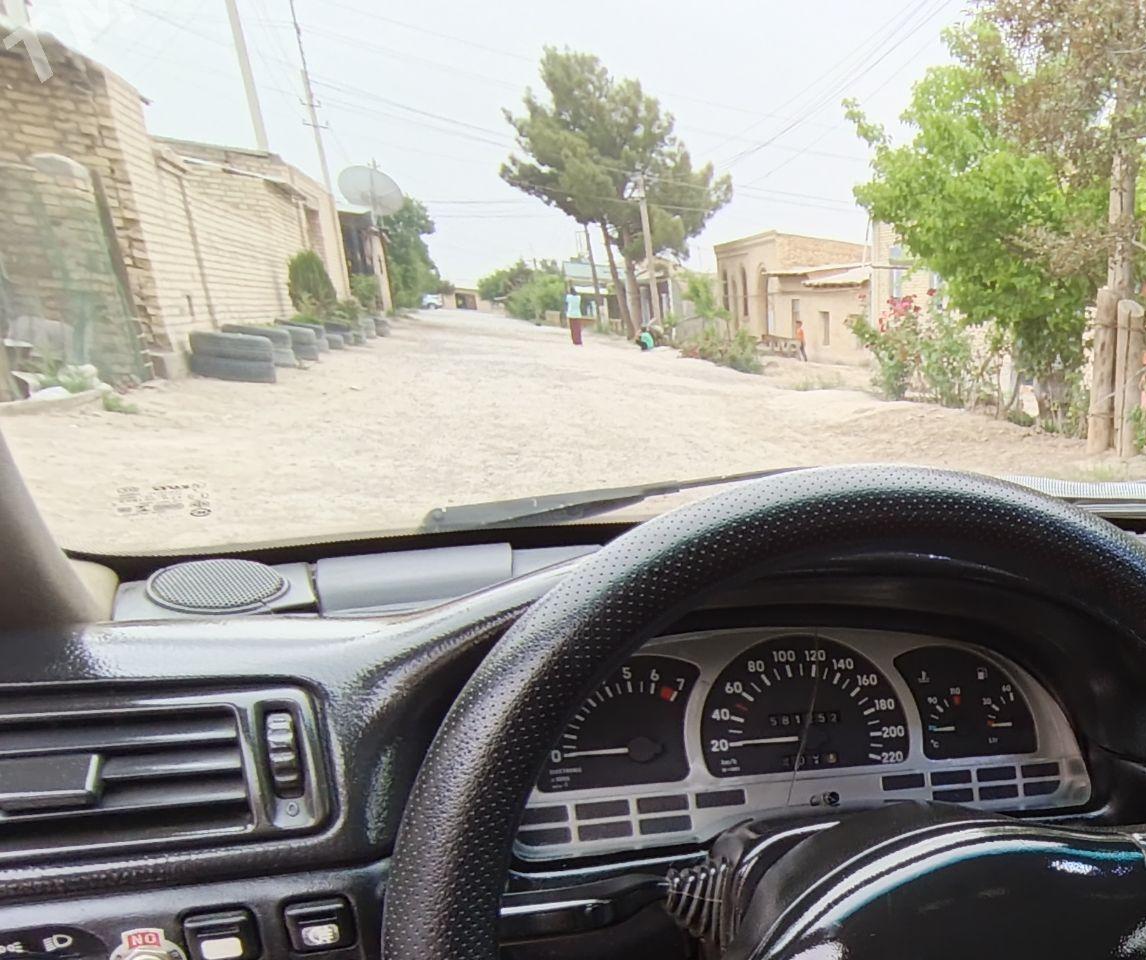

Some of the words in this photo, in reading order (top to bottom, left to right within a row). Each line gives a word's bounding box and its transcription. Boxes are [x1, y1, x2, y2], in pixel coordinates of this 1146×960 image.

[772, 650, 796, 662] 100
[805, 649, 826, 662] 120
[747, 660, 765, 673] 80
[832, 658, 854, 671] 140
[622, 667, 632, 679] 5
[650, 669, 660, 682] 6
[676, 678, 686, 691] 7
[857, 674, 877, 687] 160
[725, 681, 743, 694] 60
[874, 698, 895, 711] 180
[927, 696, 938, 705] 90
[711, 708, 730, 721] 40
[882, 725, 904, 738] 200
[711, 739, 729, 752] 20
[551, 750, 562, 763] 0
[881, 751, 903, 764] 220
